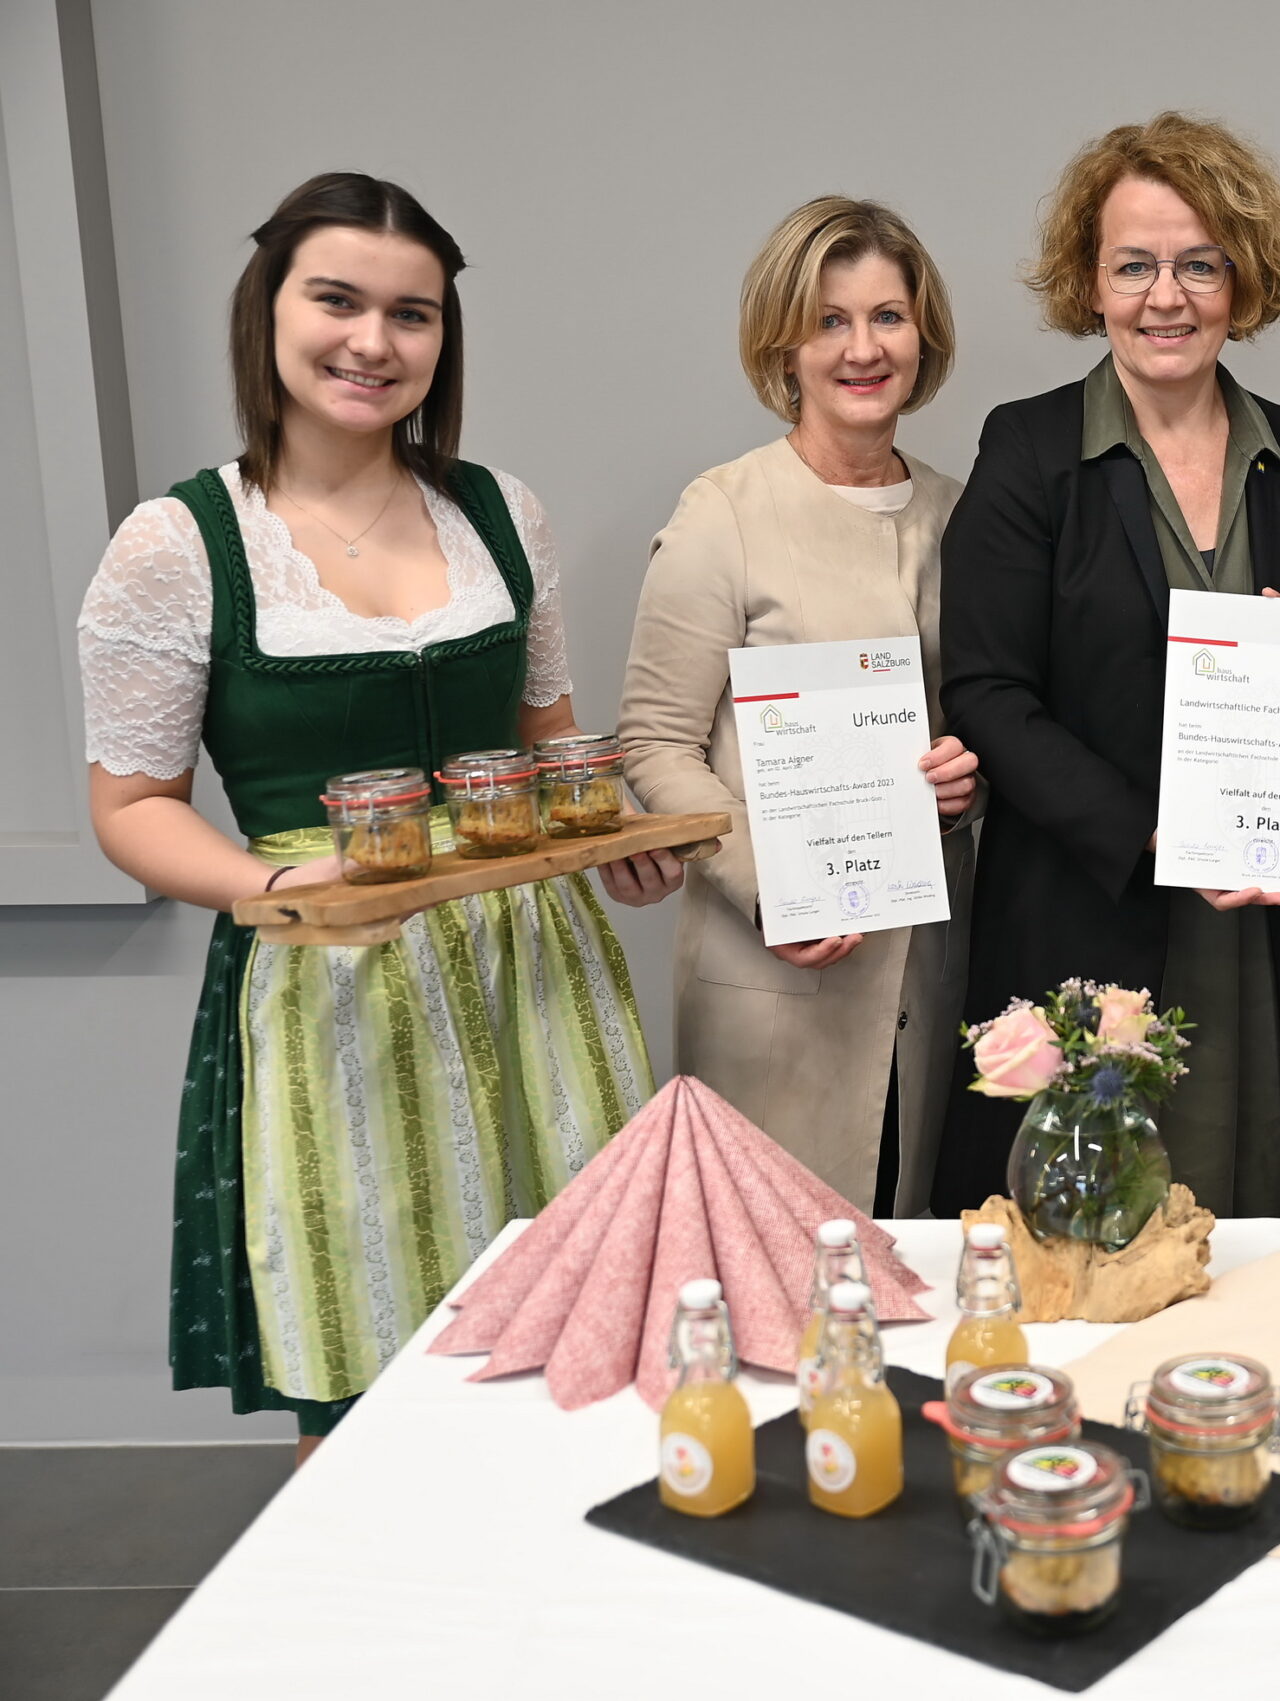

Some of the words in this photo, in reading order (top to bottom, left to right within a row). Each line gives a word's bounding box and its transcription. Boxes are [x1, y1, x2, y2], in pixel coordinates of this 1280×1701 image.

[871, 652, 891, 660] LAND
[872, 658, 910, 668] SALZBURG
[1206, 673, 1250, 684] wirtschaft
[1180, 699, 1261, 713] Landwirtschaftliche
[852, 708, 916, 728] Urkunde
[776, 724, 816, 736] wirtschaft
[756, 758, 786, 767] Tamara
[788, 754, 814, 765] Aigner
[760, 781, 875, 800] Bundes-Hauswirtschafts-Award
[877, 778, 895, 788] 2023
[1220, 788, 1250, 798] Vielfalt
[1236, 815, 1250, 829] 3.
[807, 836, 835, 847] Vielfalt
[836, 835, 850, 844] auf
[851, 833, 866, 842] den
[866, 830, 892, 840] Tellern
[827, 862, 840, 876] 3.
[846, 859, 881, 873] Platz
